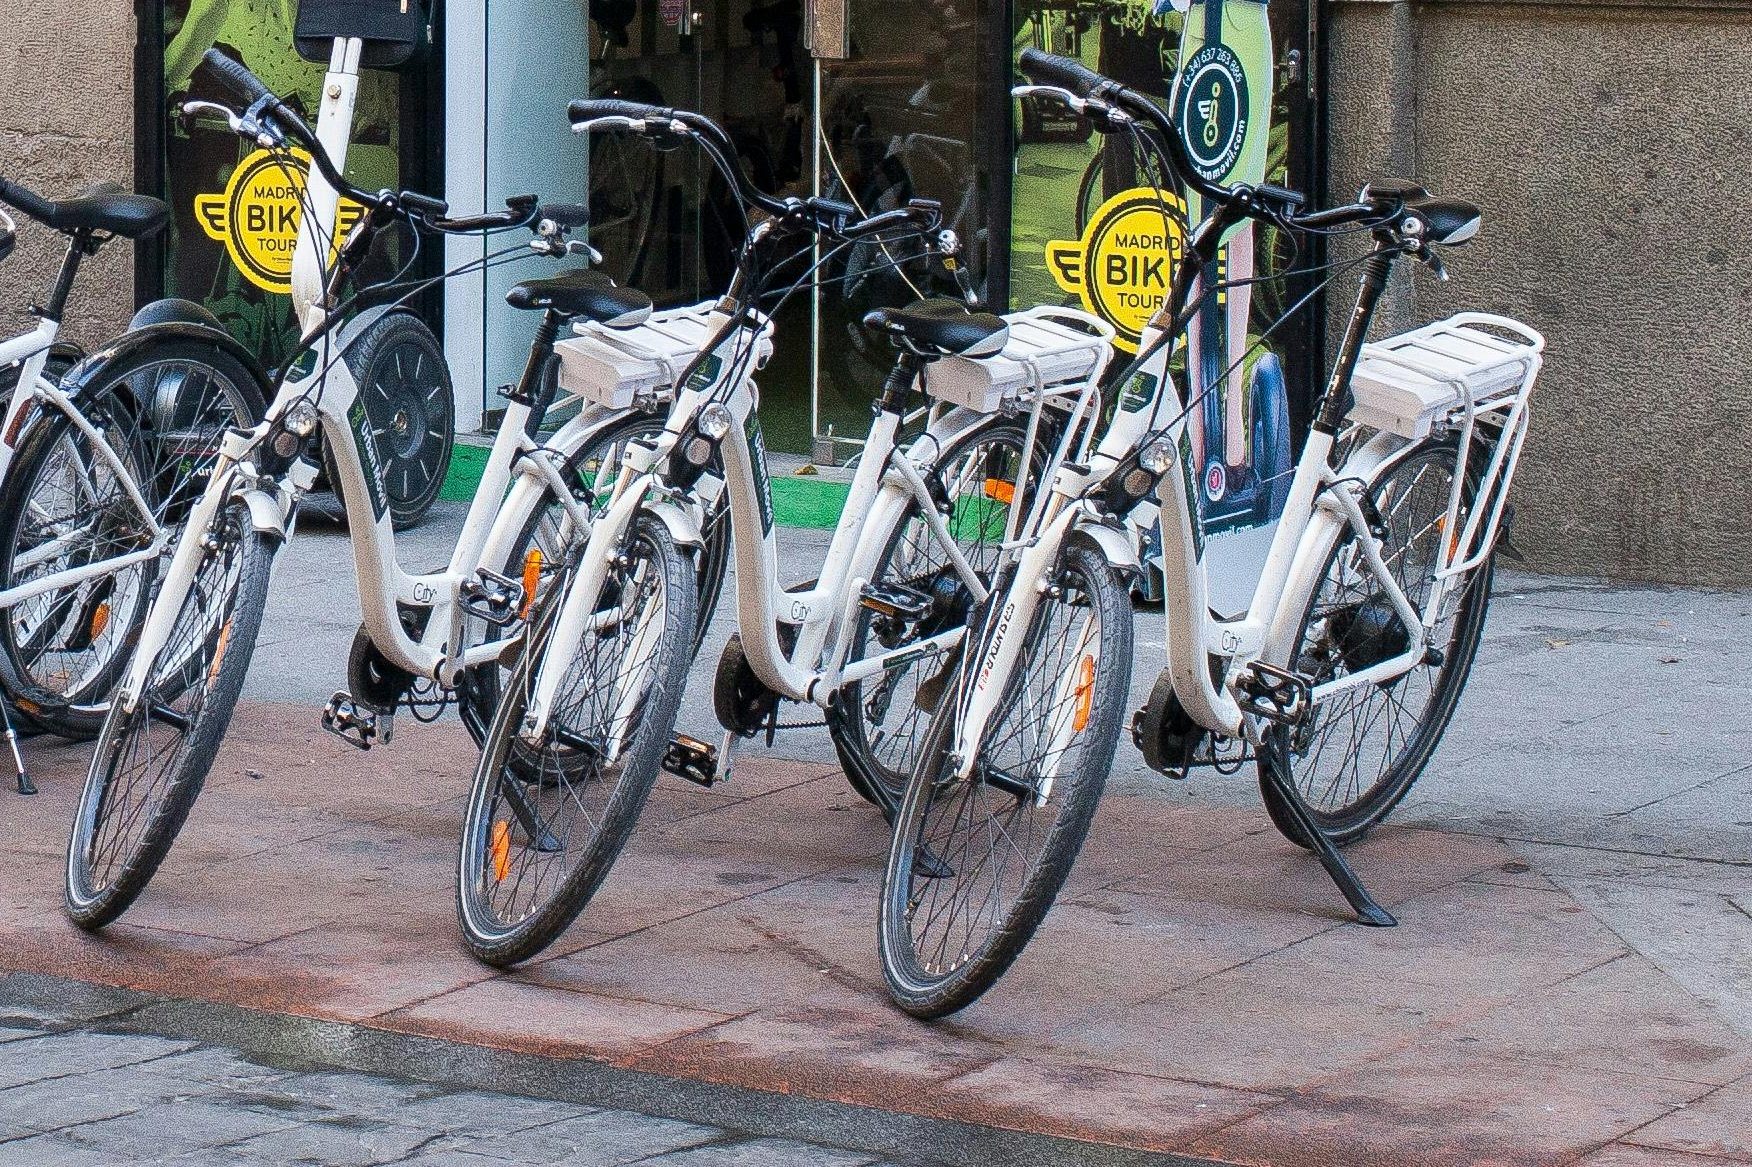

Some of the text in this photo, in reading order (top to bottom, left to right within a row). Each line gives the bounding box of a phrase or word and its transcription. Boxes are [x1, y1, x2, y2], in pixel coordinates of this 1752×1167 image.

[1183, 56, 1201, 88] (+34)
[1201, 48, 1216, 63] 637
[248, 204, 298, 233] BIK
[257, 239, 297, 251] TOUR
[1115, 233, 1180, 251] MADRID
[1107, 254, 1172, 288] BIK
[1117, 292, 1164, 309] TOUR
[361, 421, 378, 465] Urban
